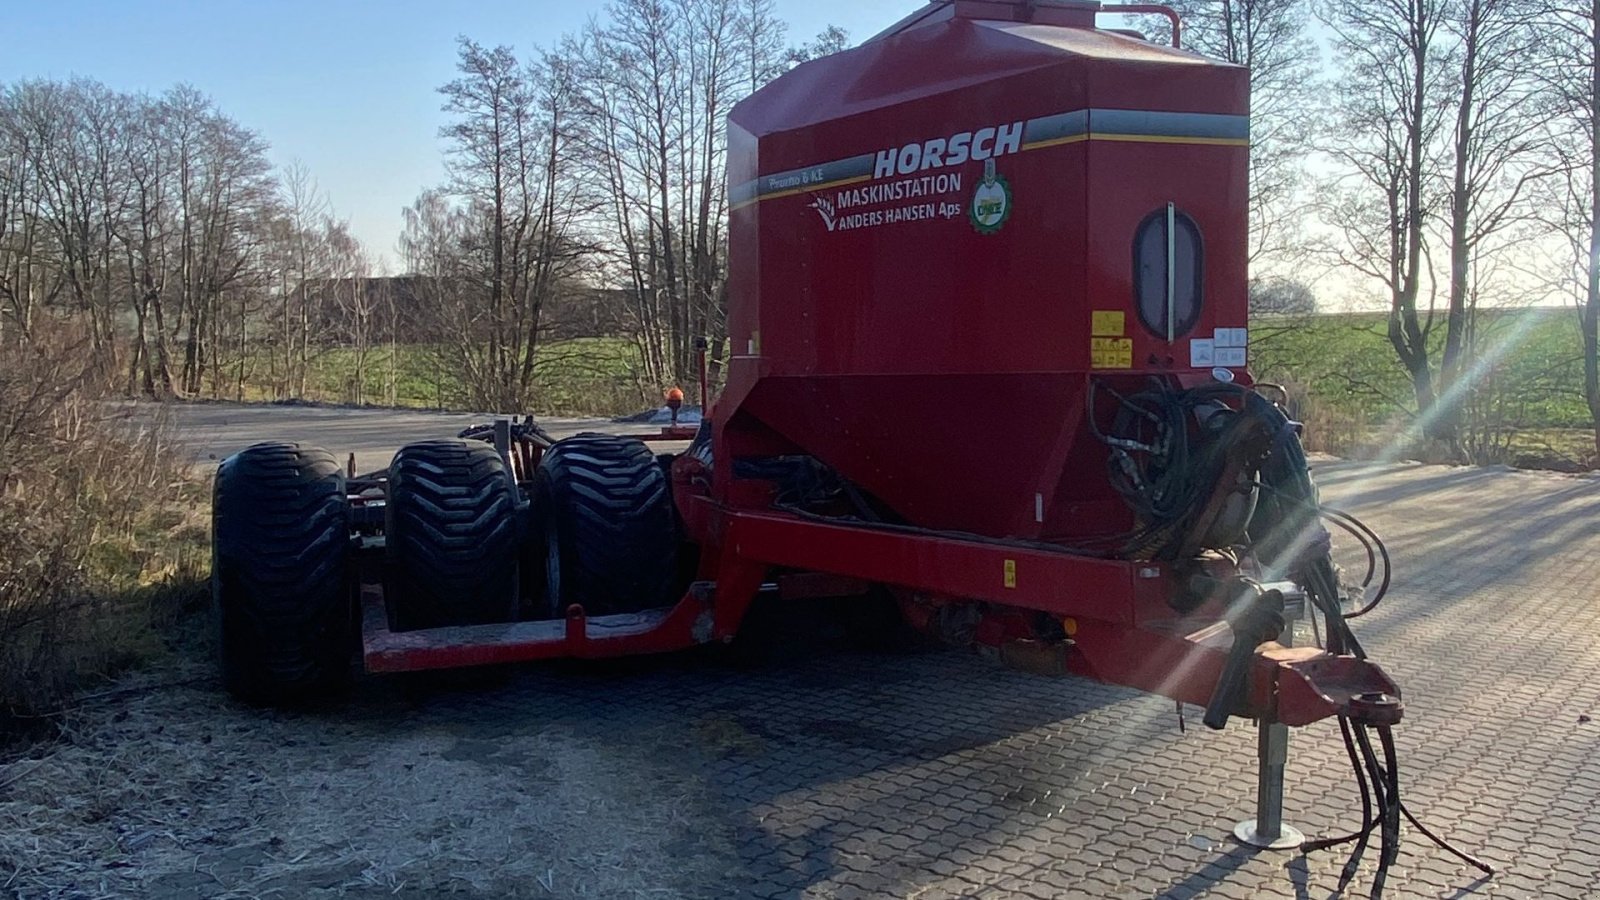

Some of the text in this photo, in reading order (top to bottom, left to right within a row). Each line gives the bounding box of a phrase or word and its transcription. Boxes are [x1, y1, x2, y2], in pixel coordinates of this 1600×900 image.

[874, 121, 1023, 178] HORSCH
[837, 173, 962, 209] MASKINSTATION
[838, 201, 961, 231] ANDERS HANSEN Aps
